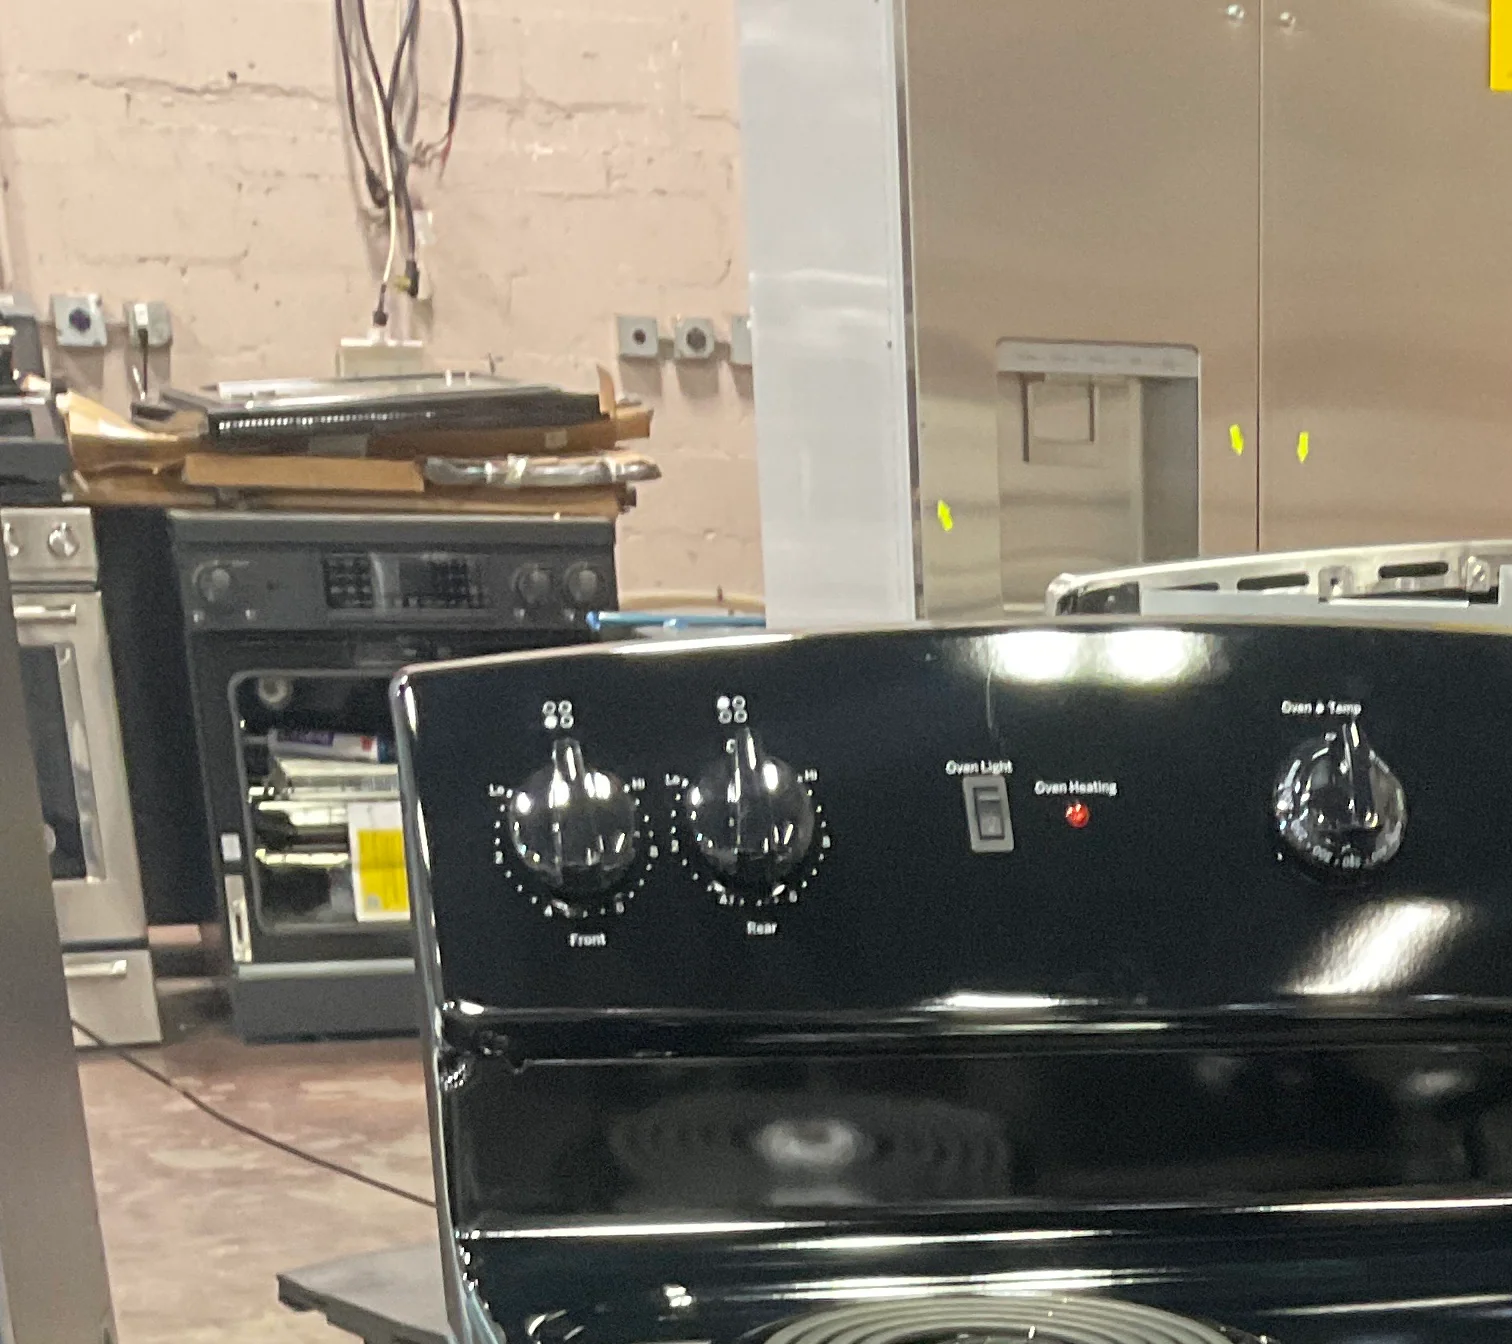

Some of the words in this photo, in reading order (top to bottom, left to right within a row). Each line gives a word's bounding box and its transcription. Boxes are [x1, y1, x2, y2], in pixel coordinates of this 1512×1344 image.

[1281, 700, 1313, 714] Oven
[945, 759, 979, 775] Oven
[980, 760, 1013, 775] Light
[1034, 780, 1067, 795] Oven
[1068, 780, 1118, 796] Heating
[747, 920, 778, 936] Rear
[569, 932, 607, 948] Front
